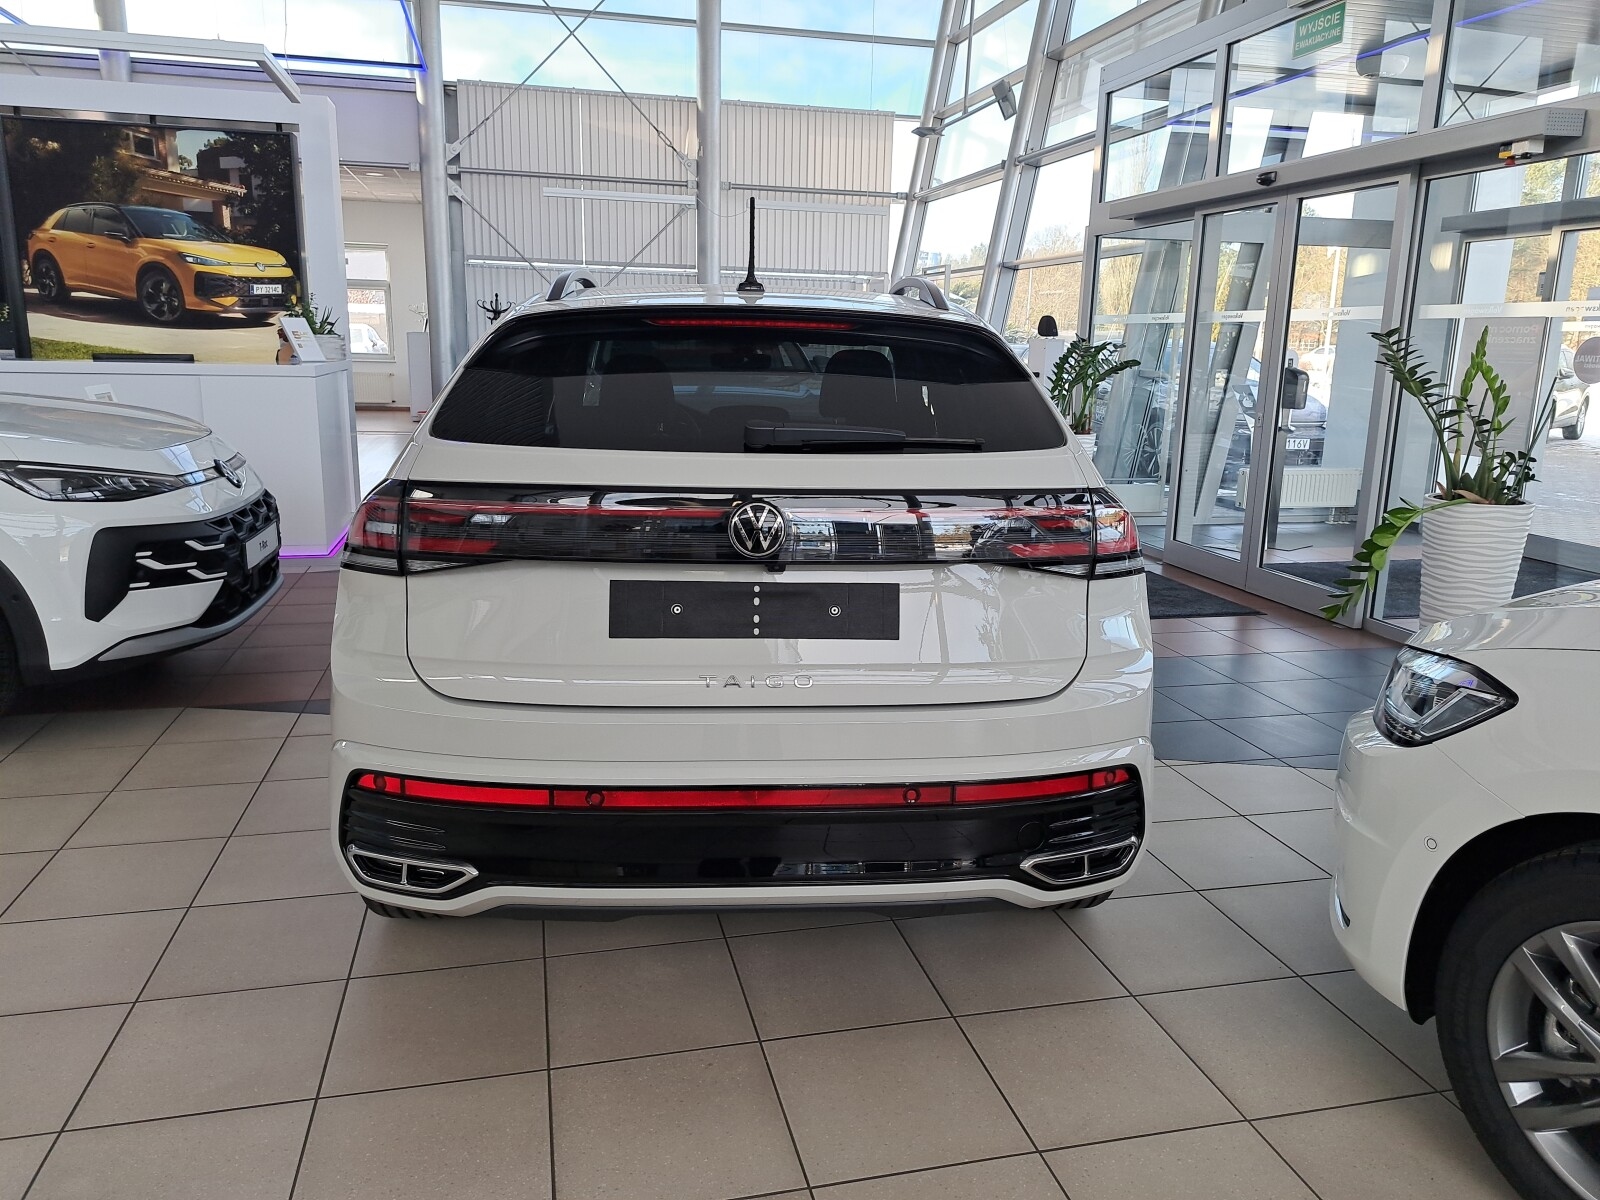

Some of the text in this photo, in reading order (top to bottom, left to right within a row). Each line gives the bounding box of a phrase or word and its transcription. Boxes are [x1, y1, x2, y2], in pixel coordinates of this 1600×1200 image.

[1299, 11, 1341, 37] WYJŚCIE
[1296, 27, 1341, 50] EWAKUACYJNE
[699, 674, 814, 689] TAIGO
